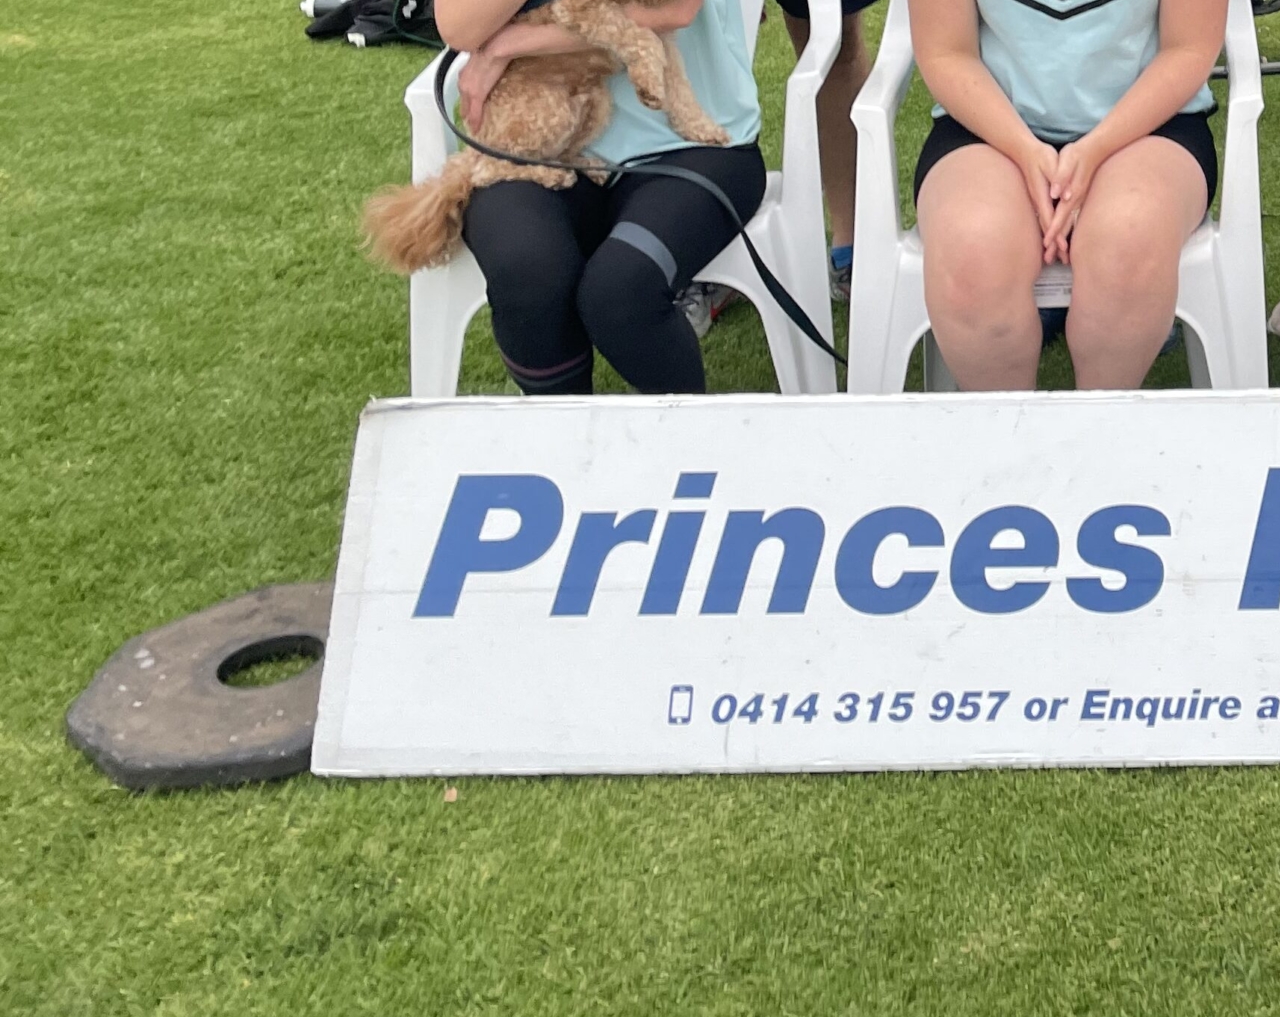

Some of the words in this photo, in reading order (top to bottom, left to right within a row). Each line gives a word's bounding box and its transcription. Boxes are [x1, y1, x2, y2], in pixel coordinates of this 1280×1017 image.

[413, 471, 1171, 618] Princes
[711, 691, 819, 725] 0414
[834, 691, 913, 723] 315
[930, 690, 1009, 722] 957
[1022, 696, 1067, 722] or
[1079, 688, 1242, 727] Enquire
